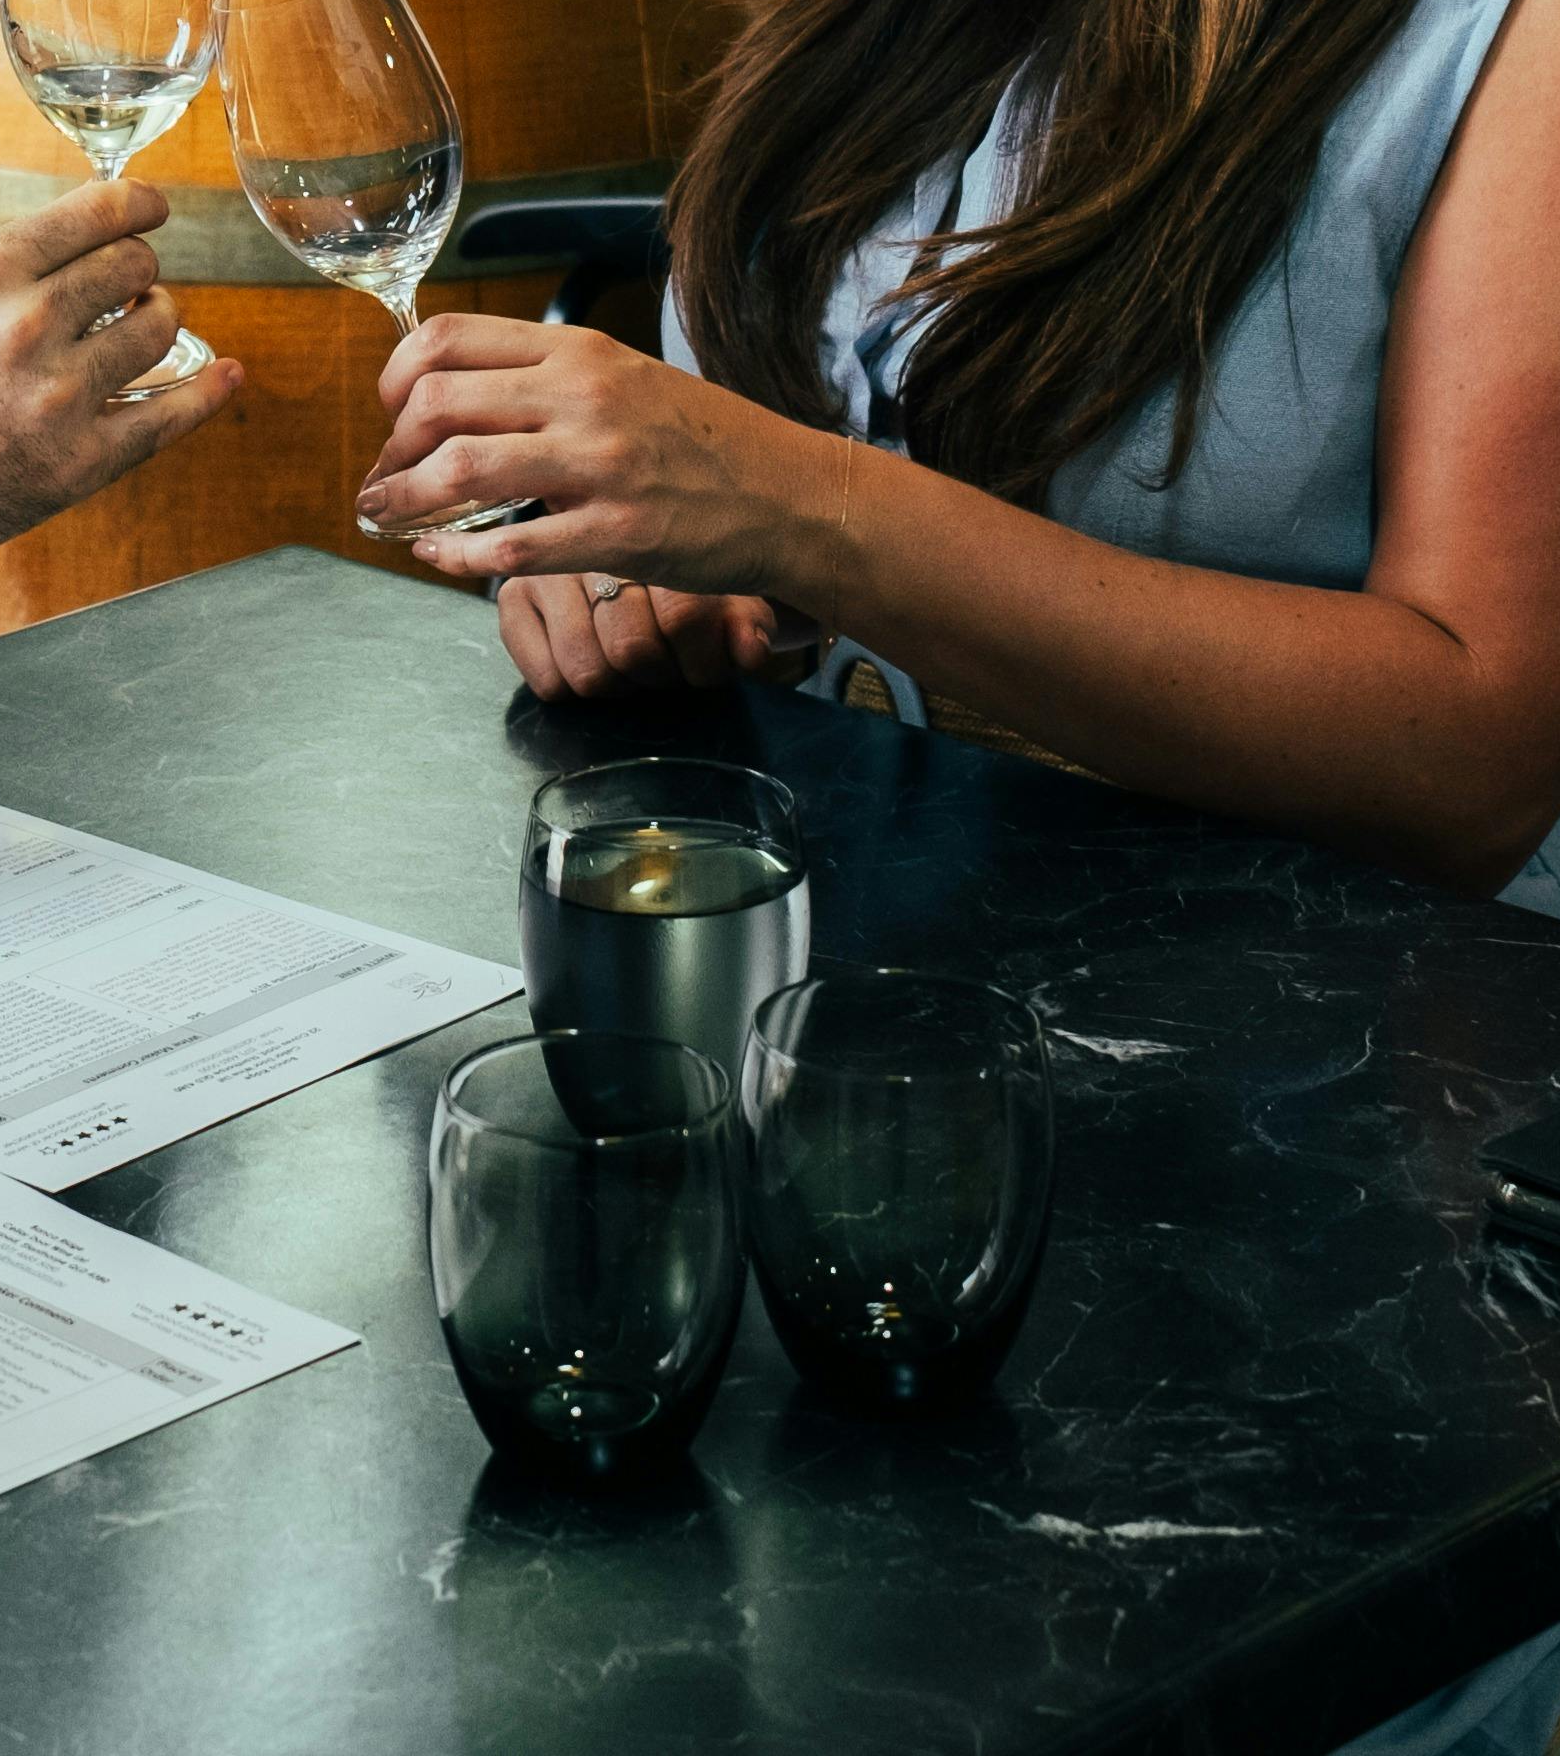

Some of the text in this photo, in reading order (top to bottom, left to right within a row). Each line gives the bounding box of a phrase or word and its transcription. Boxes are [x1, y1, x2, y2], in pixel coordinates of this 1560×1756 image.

[334, 952, 399, 979] WHITE WINE
[137, 1045, 176, 1061] Maker
[82, 1059, 142, 1084] Comments
[16, 1296, 80, 1325] Comments
[137, 1366, 177, 1384] Order
